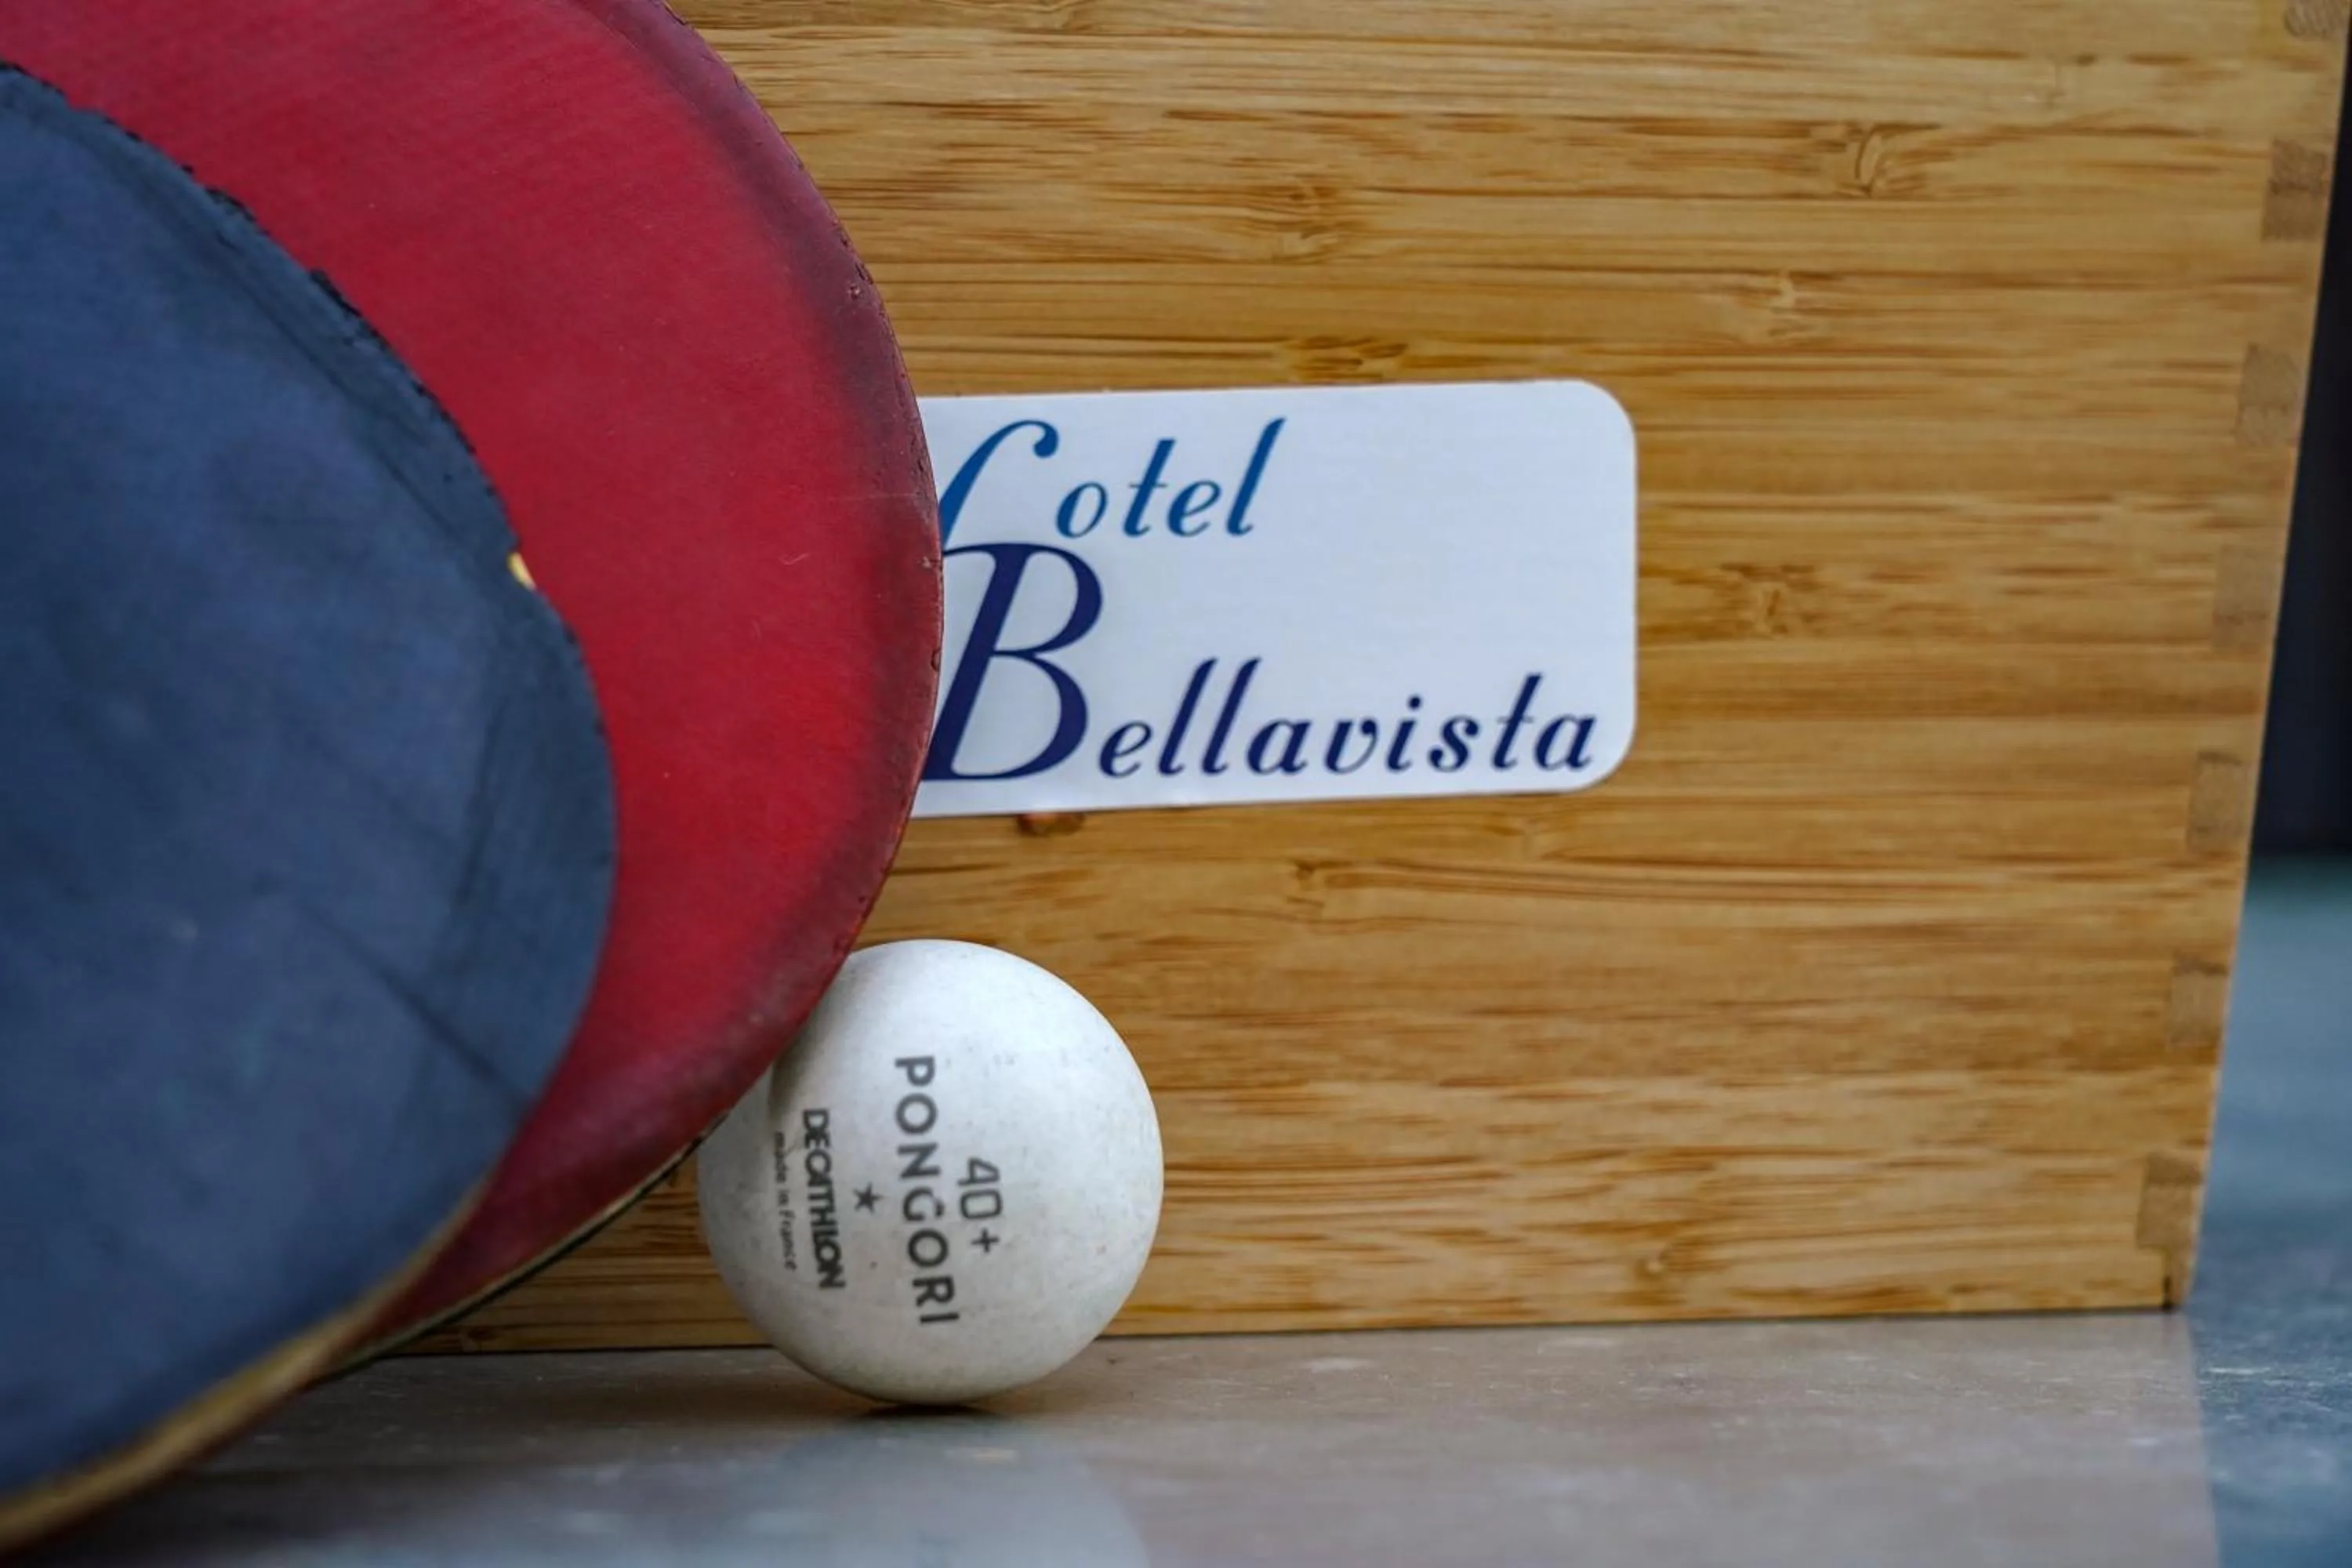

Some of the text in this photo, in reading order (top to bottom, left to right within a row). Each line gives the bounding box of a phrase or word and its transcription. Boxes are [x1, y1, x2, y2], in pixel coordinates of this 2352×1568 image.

[920, 542, 1598, 782] Bellavista
[803, 1107, 846, 1290] DECATHLON
[895, 1055, 959, 1324] PONGORI
[957, 1156, 1002, 1253] 40+
